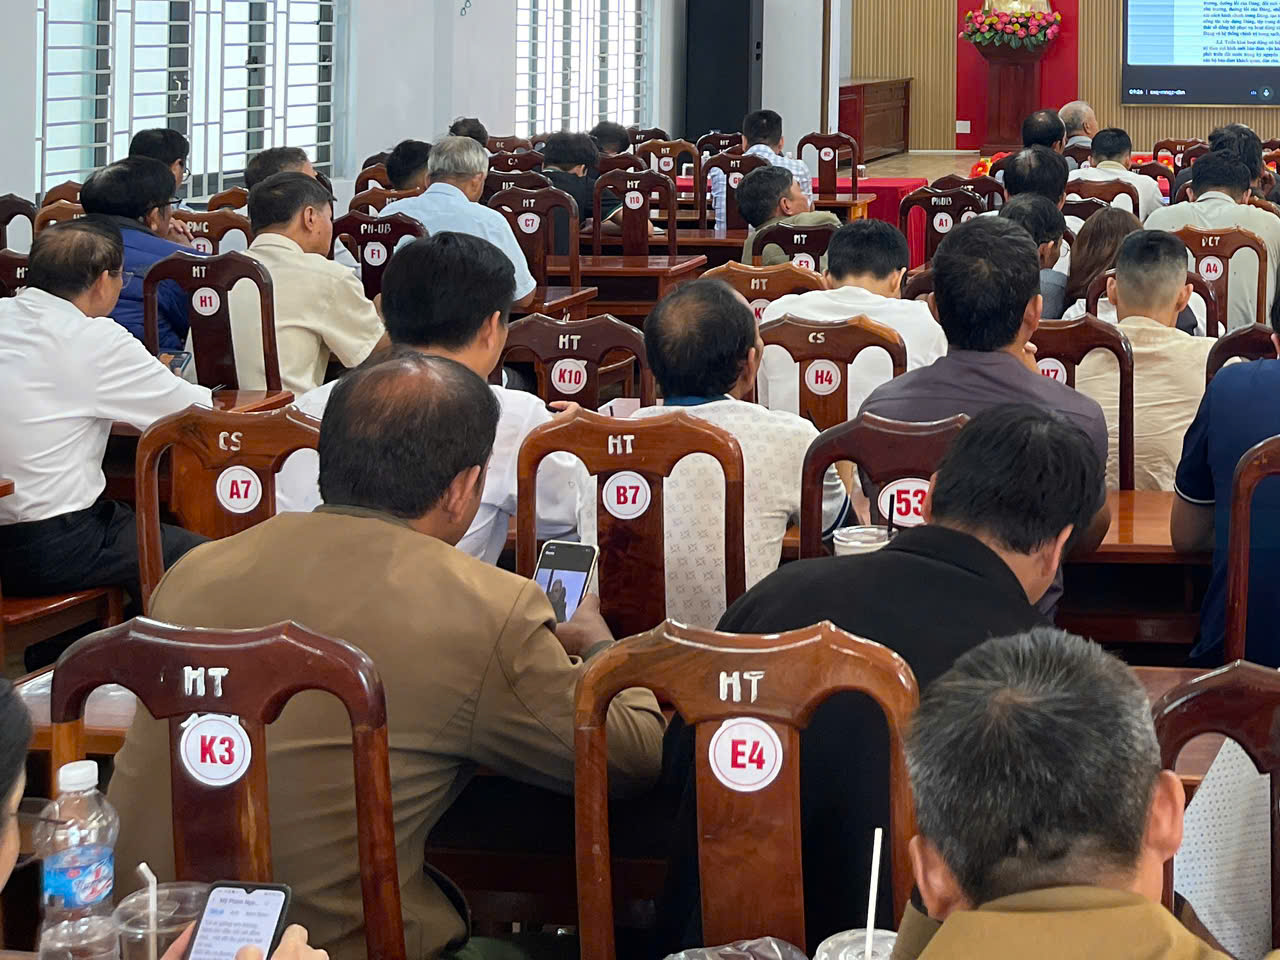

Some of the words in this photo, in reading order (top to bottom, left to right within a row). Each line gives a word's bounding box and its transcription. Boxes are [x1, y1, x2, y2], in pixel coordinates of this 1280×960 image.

[525, 218, 534, 228] C7
[938, 218, 948, 228] A1
[371, 249, 381, 259] F1
[1205, 262, 1218, 274] A4
[200, 296, 213, 308] H1
[808, 333, 825, 344] CS
[558, 368, 582, 386] K10
[814, 369, 834, 386] H4
[218, 432, 243, 452] CS
[229, 480, 252, 500] A7
[616, 485, 640, 505] B7
[896, 490, 926, 516] 53
[200, 734, 236, 766] K3
[730, 739, 766, 770] E4
